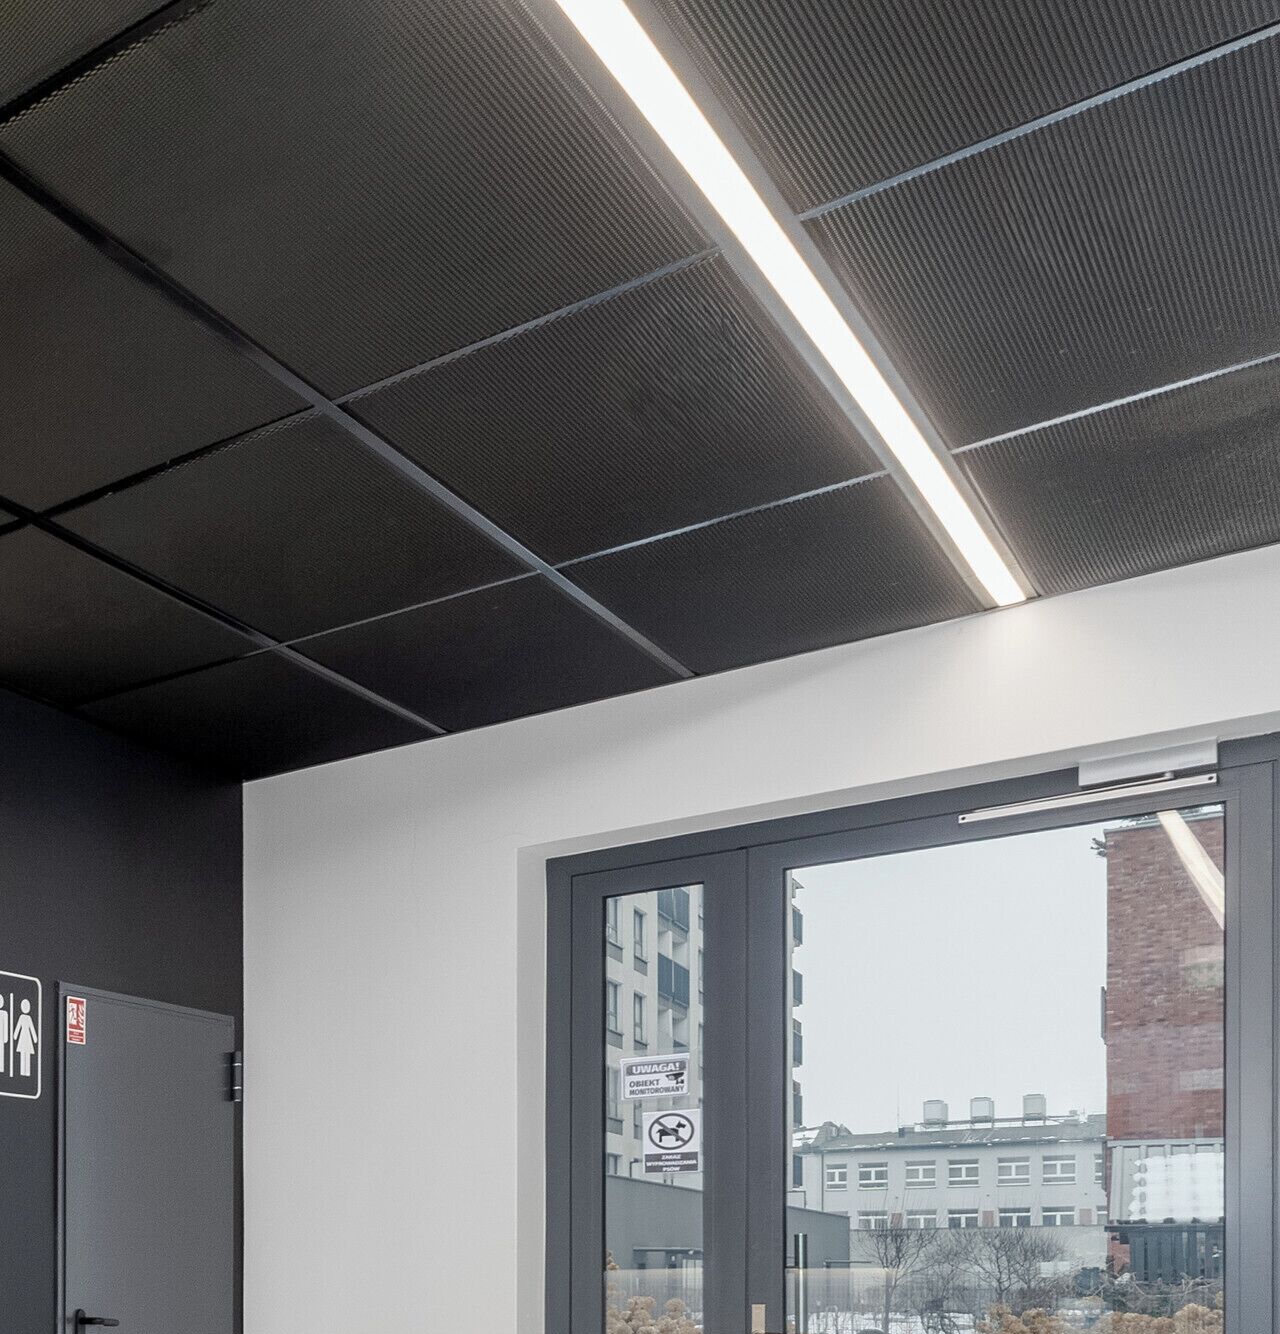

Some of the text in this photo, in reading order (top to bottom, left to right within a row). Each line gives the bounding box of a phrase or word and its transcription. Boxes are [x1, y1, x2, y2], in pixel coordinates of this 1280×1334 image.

[632, 1062, 680, 1074] UWAGA!
[629, 1079, 660, 1088] OBIEKT
[629, 1085, 685, 1097] MONITOROWANY
